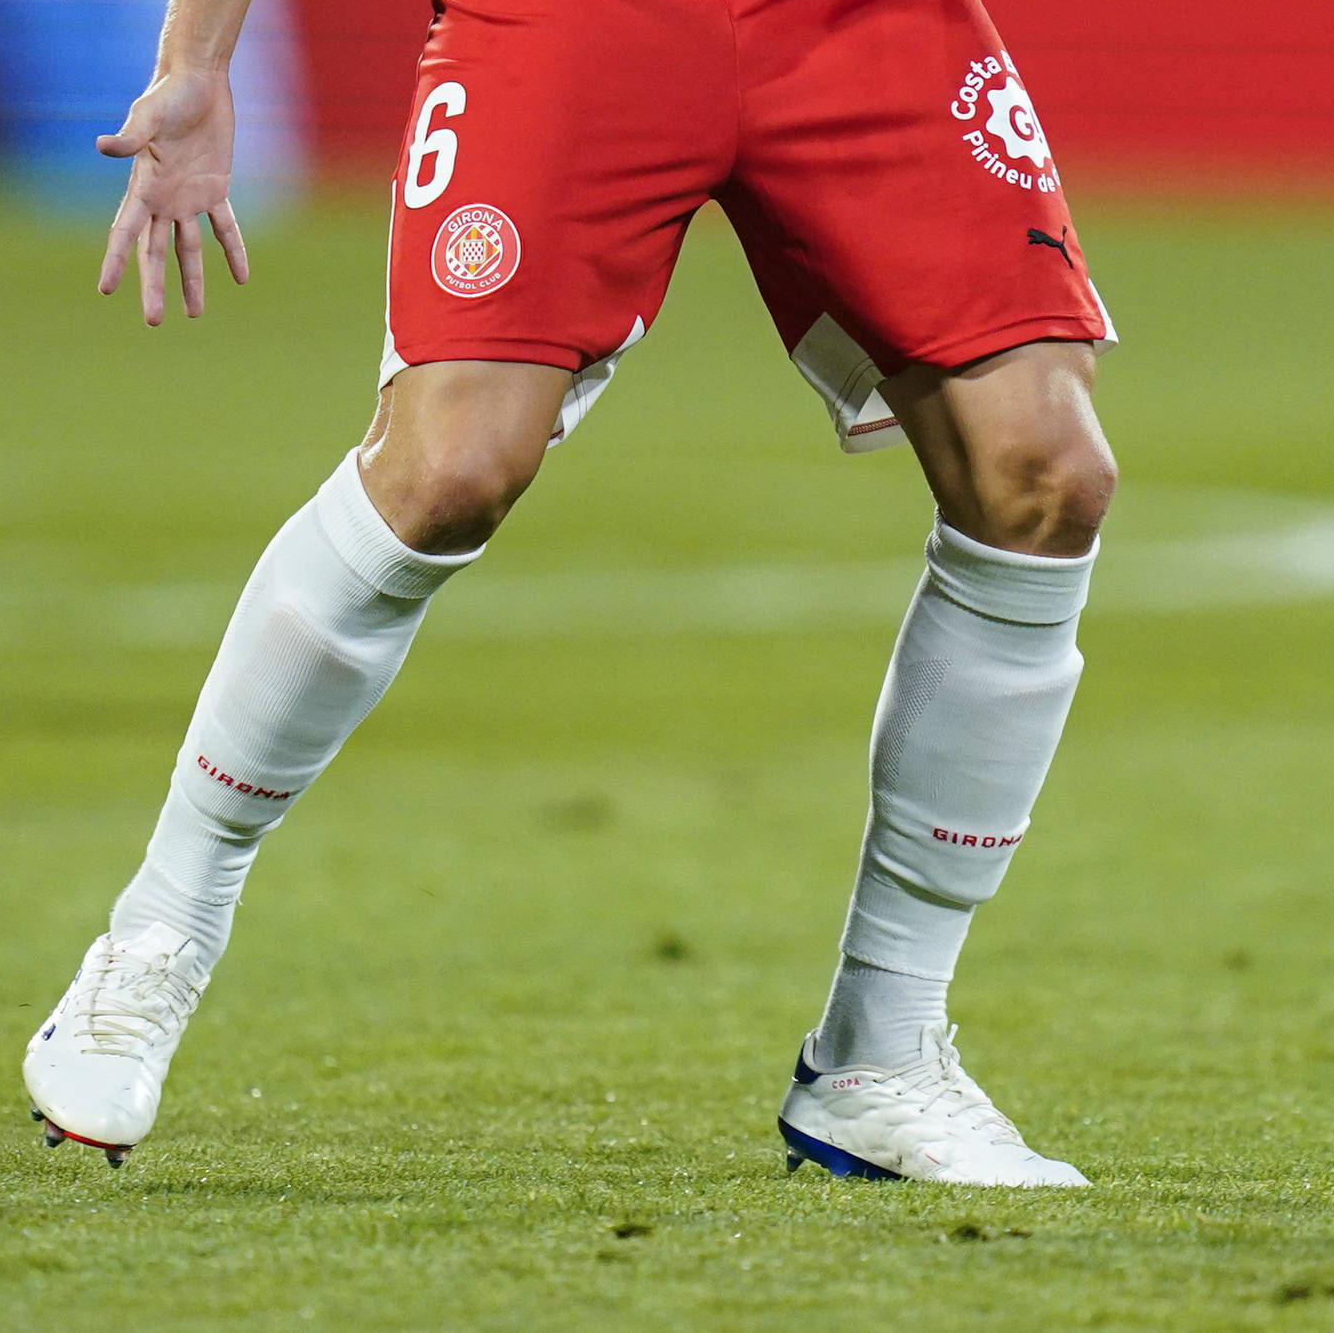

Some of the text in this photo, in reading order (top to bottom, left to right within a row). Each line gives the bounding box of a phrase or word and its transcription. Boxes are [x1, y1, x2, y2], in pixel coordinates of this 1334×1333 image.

[951, 56, 1003, 120] Costa
[404, 81, 466, 209] 6
[962, 129, 1033, 190] Pirineu
[1037, 173, 1056, 193] de
[448, 210, 503, 232] GIRONA
[445, 272, 502, 289] FUTBOL CLUB
[832, 1077, 860, 1089] COPA
